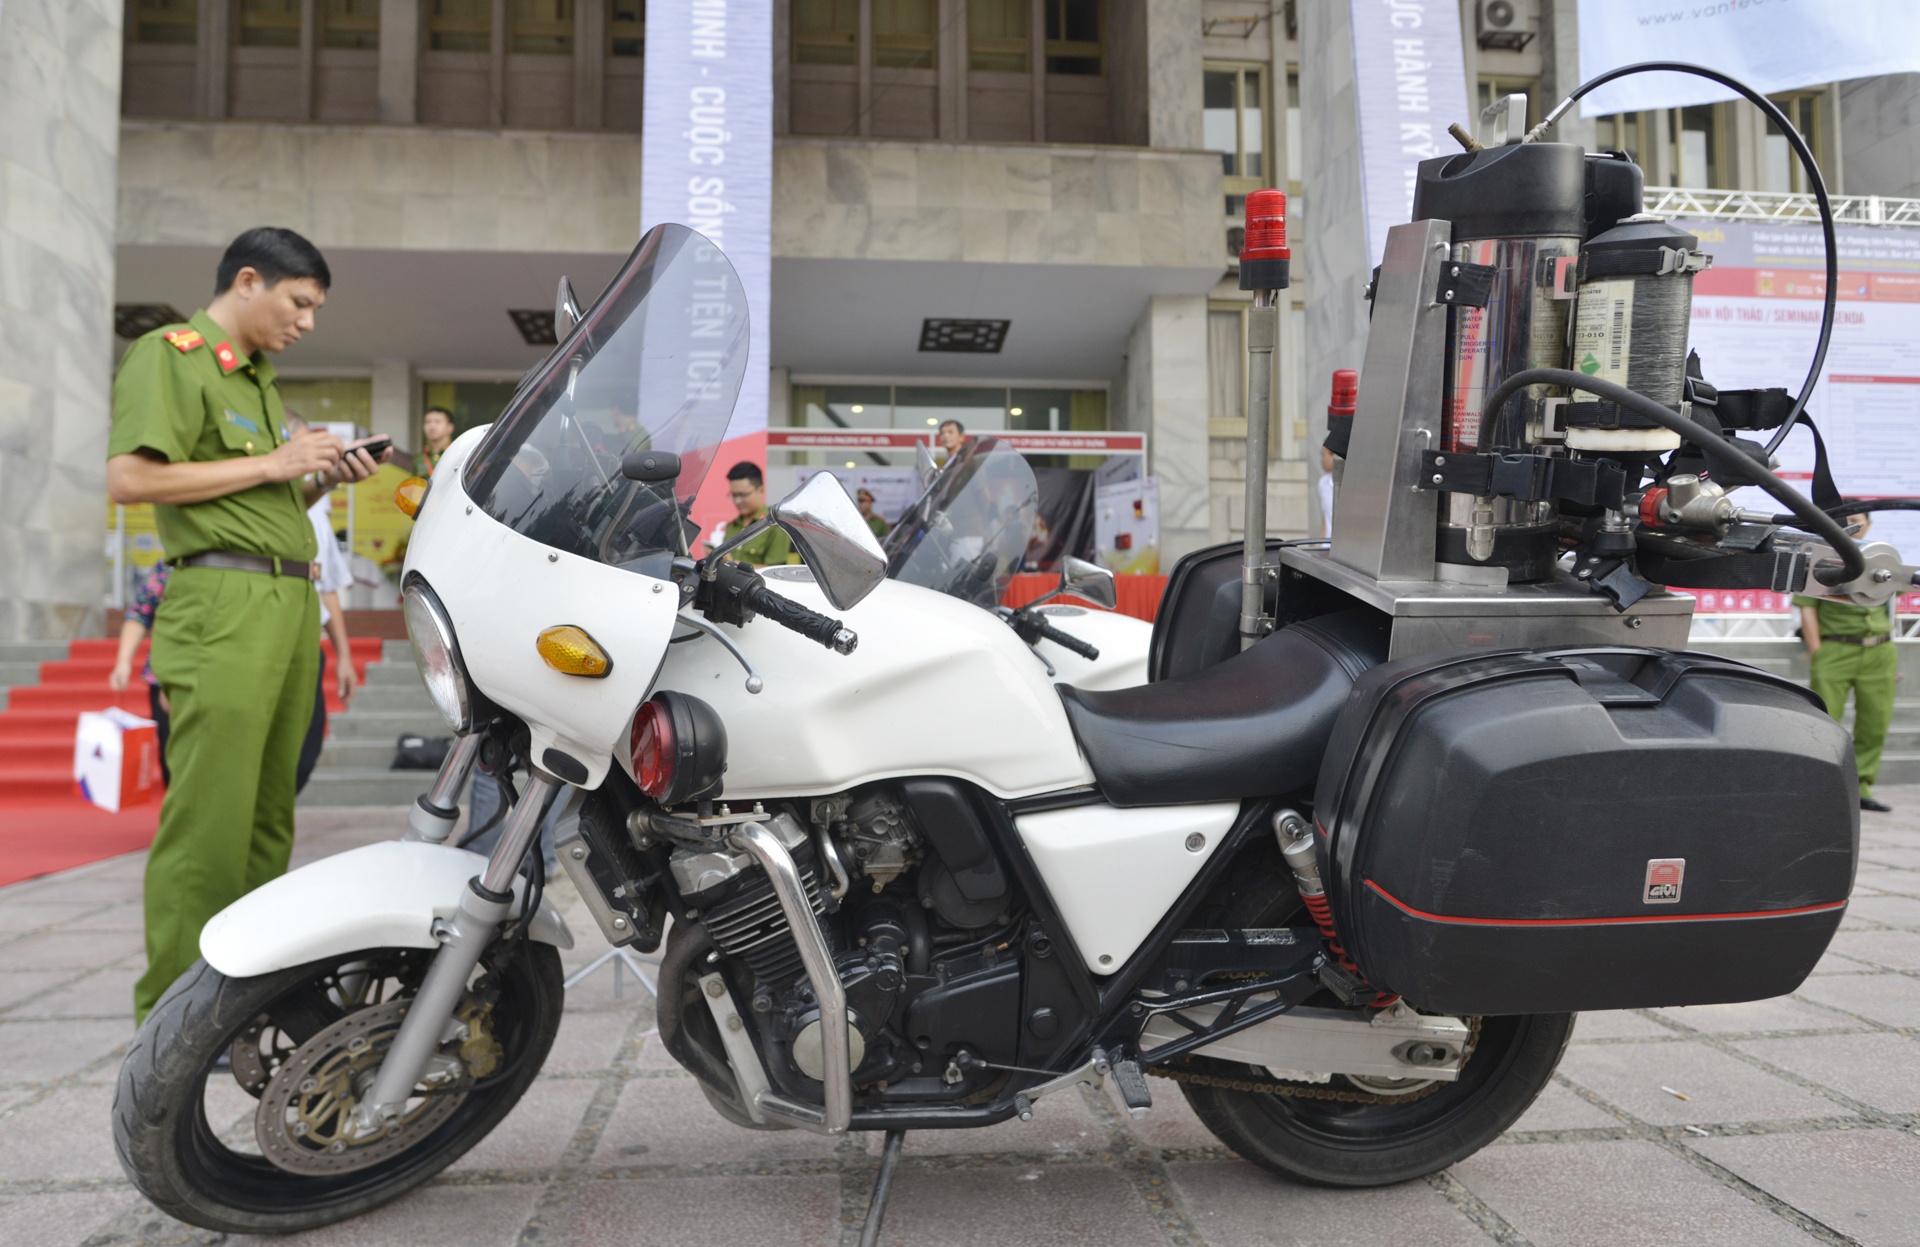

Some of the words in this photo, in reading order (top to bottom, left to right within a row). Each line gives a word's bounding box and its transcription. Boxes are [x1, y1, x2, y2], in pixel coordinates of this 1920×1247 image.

[1393, 39, 1432, 112] HÀNH
[683, 86, 732, 165] CUỘC
[687, 175, 736, 263] SỐNG
[684, 273, 733, 338] TIỆN
[1690, 305, 1711, 319] ÌNH
[1774, 310, 1821, 324] SEMINAR
[1834, 311, 1865, 324] GENDA
